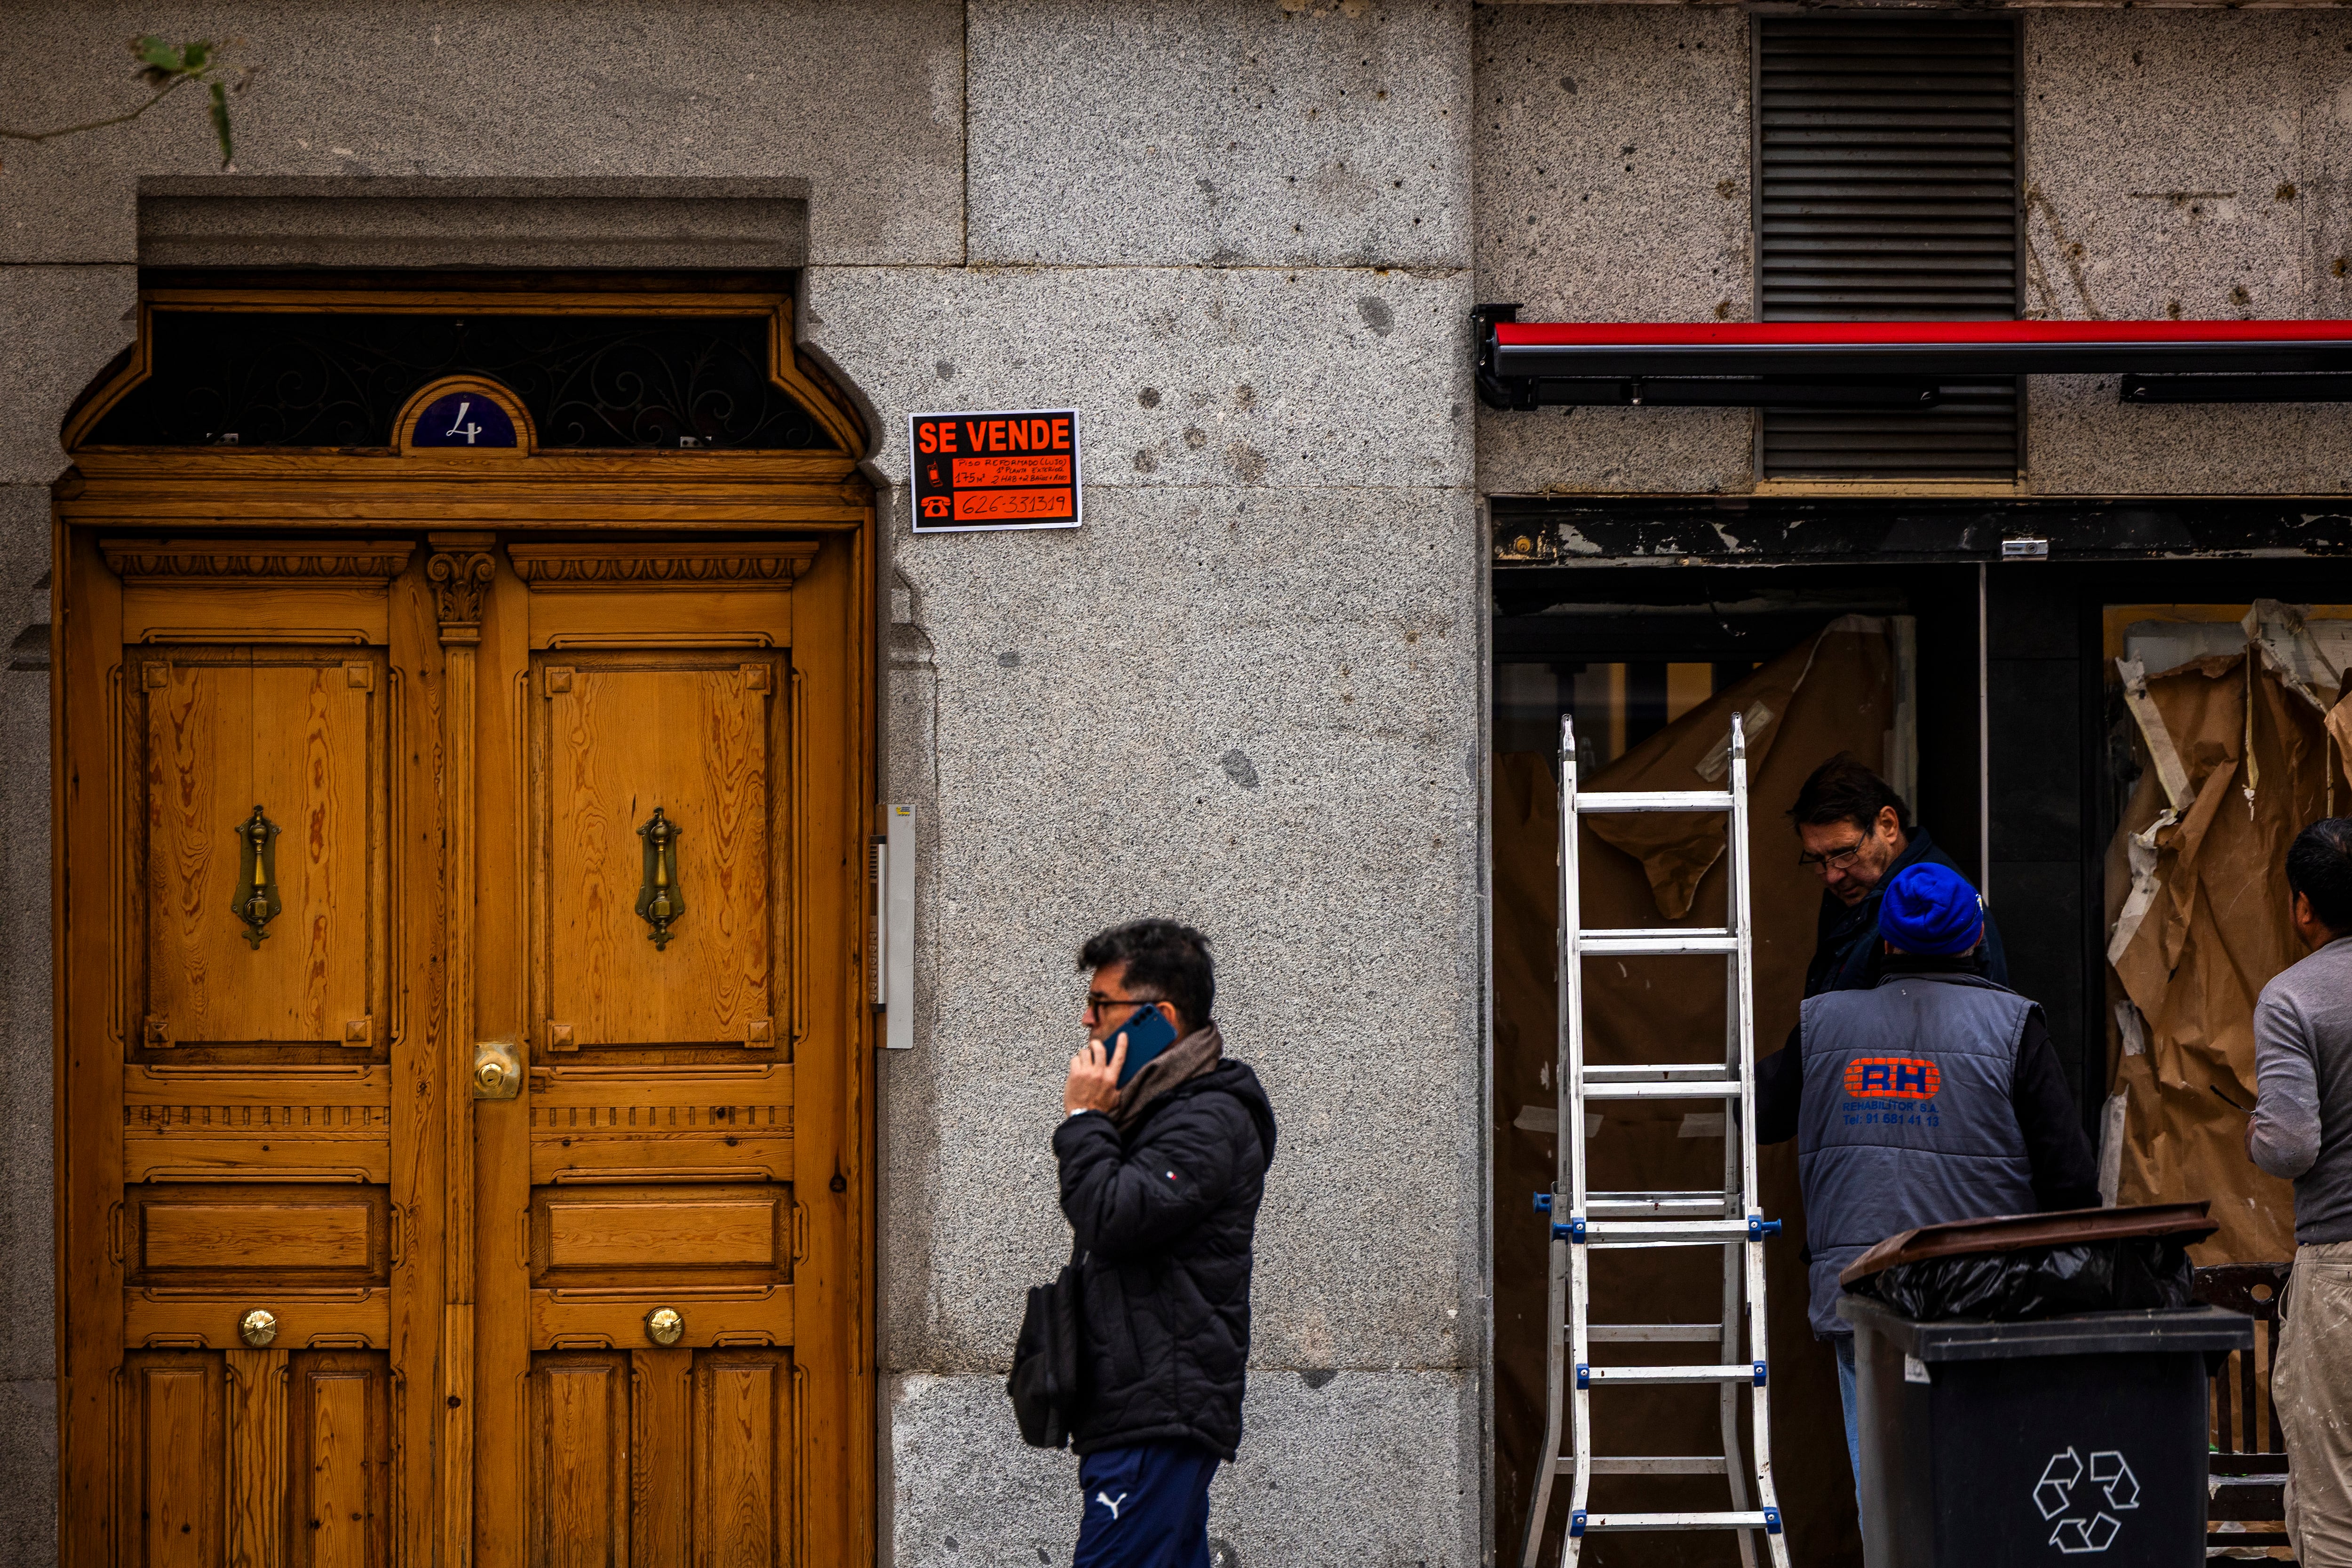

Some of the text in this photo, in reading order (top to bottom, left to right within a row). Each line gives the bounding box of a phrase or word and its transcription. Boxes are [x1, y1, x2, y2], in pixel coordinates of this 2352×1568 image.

[446, 402, 482, 444] 4
[919, 418, 1070, 454] SE VENDE
[991, 475, 999, 484] 2
[1862, 1065, 1927, 1093] RH
[1866, 1113, 1878, 1124] 91
[1883, 1113, 1903, 1125] 681
[1908, 1114, 1921, 1126] 41
[1926, 1116, 1939, 1127] 13
